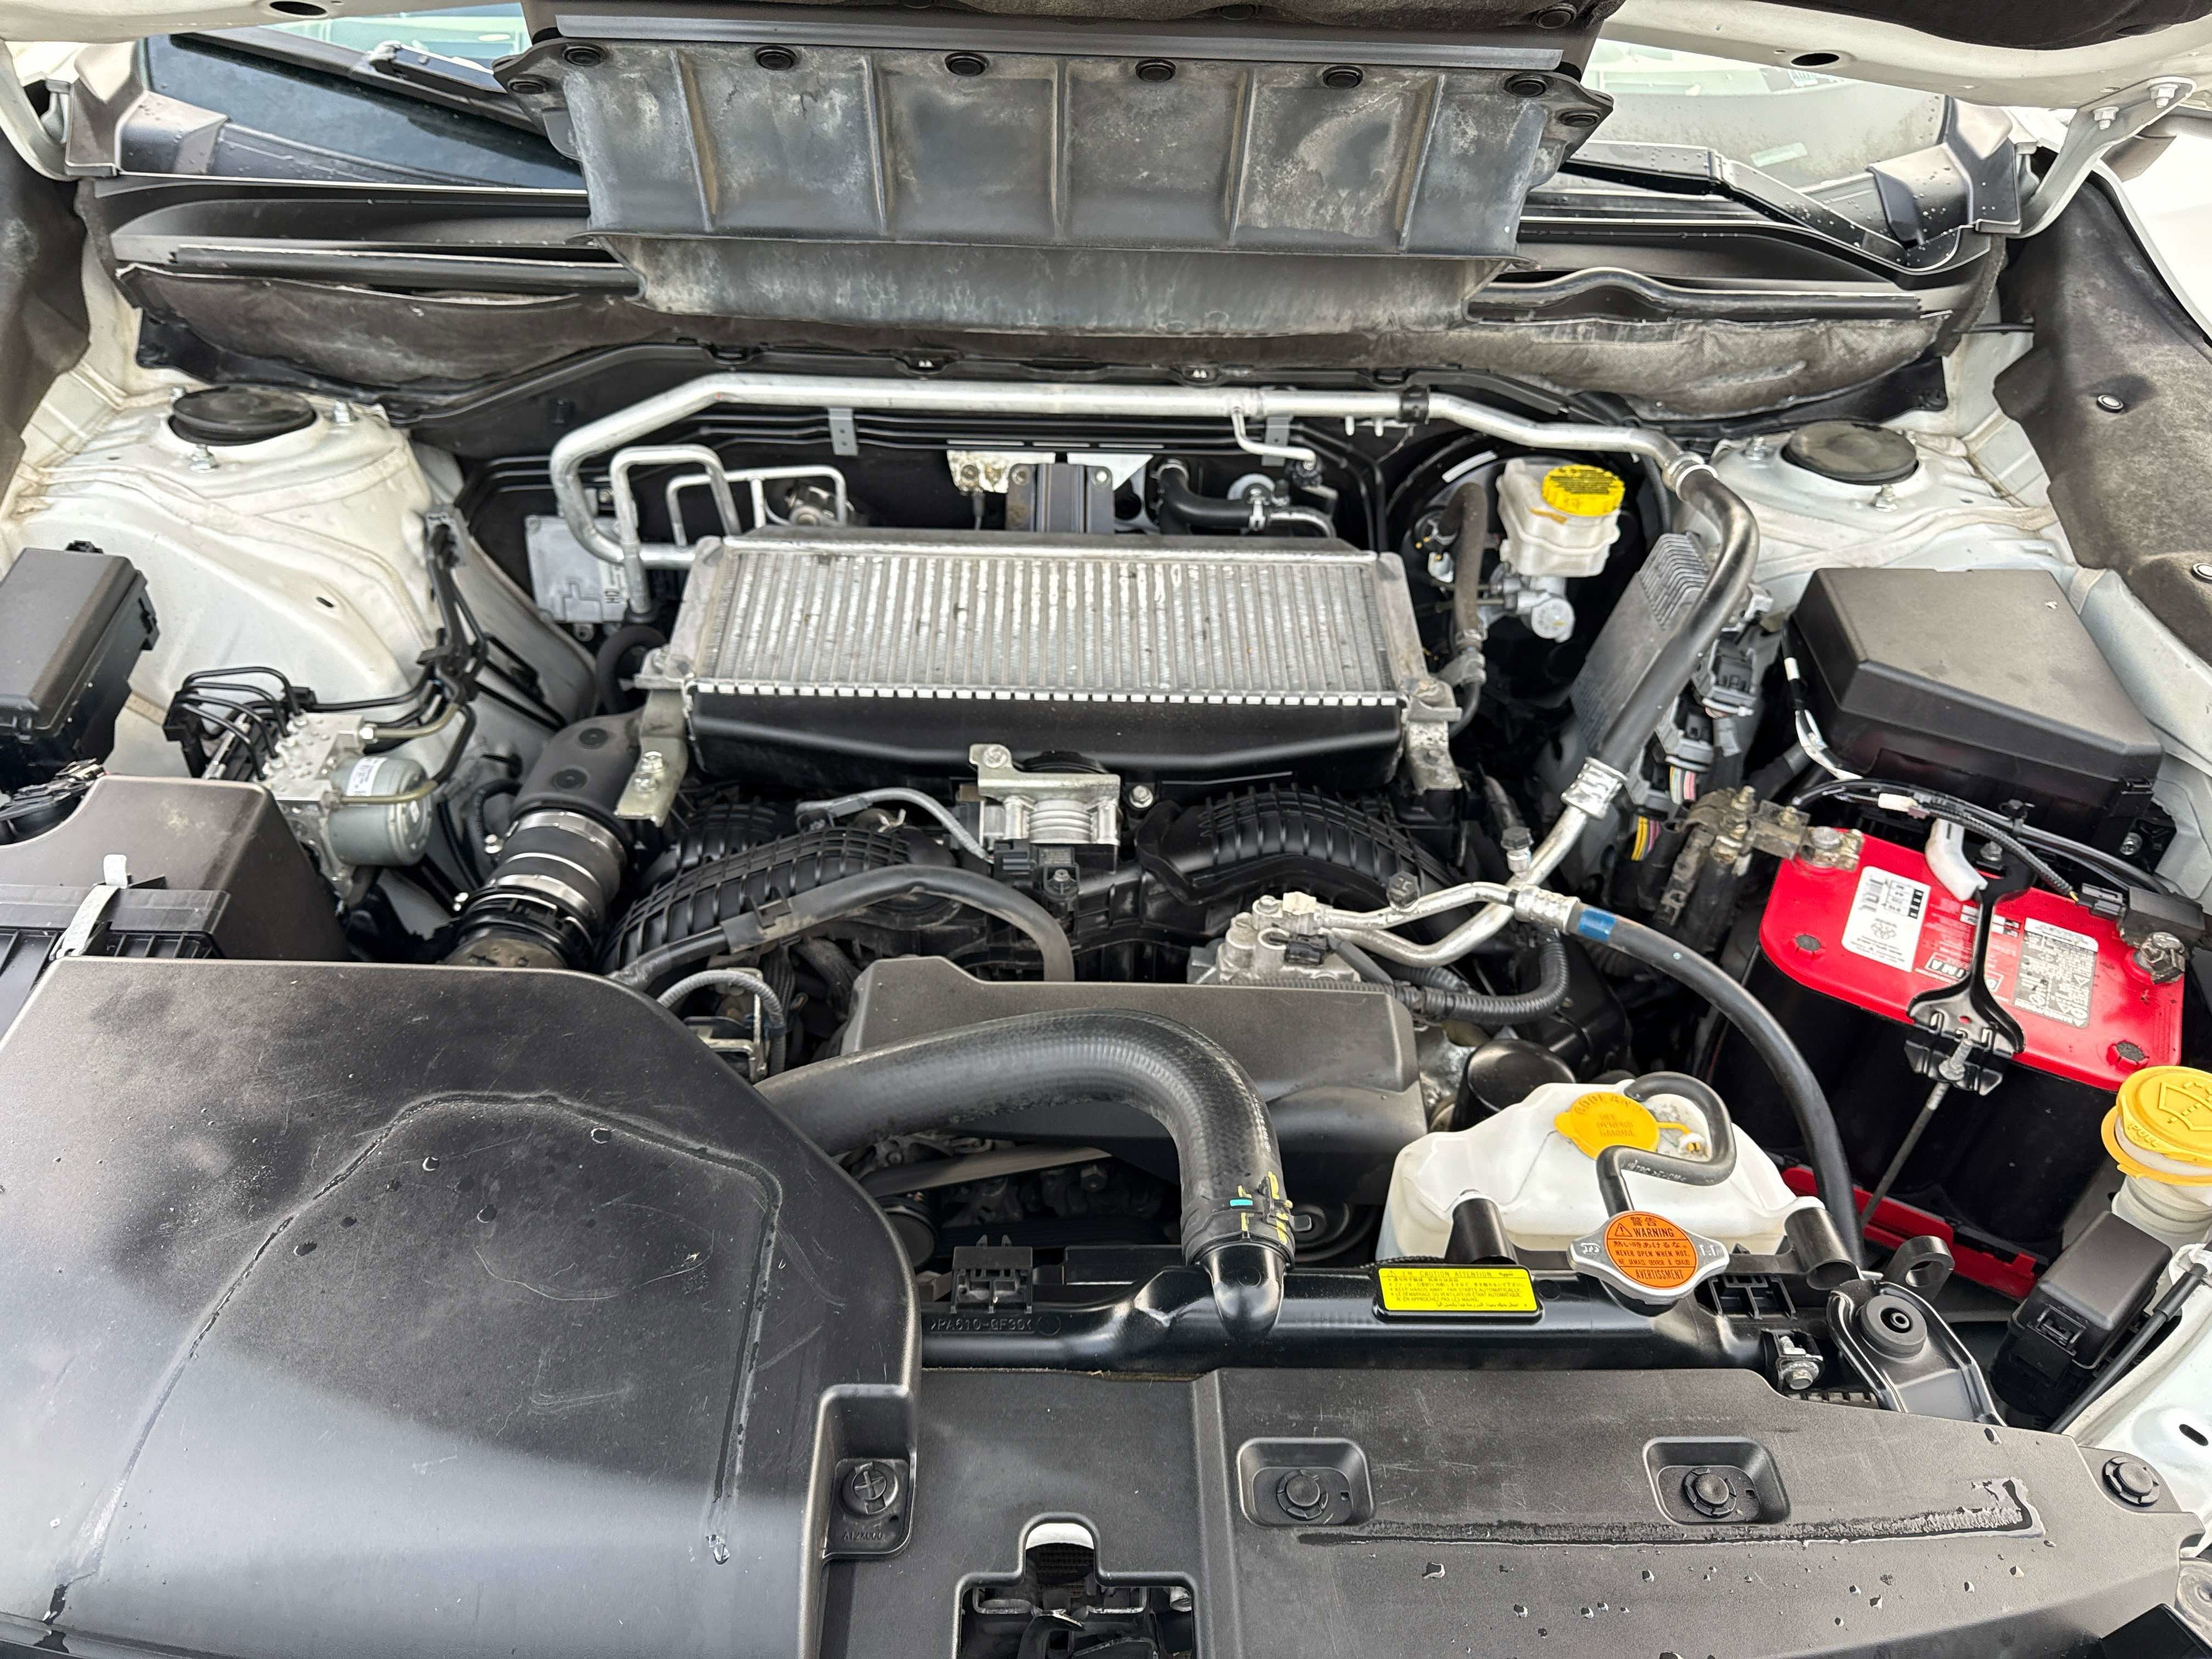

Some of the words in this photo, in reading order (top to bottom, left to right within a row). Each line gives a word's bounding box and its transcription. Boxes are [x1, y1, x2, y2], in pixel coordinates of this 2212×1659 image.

[2130, 1124, 2157, 1148] PULL
[1630, 1216, 1657, 1226] 警告
[1633, 1228, 1674, 1238] WARNING
